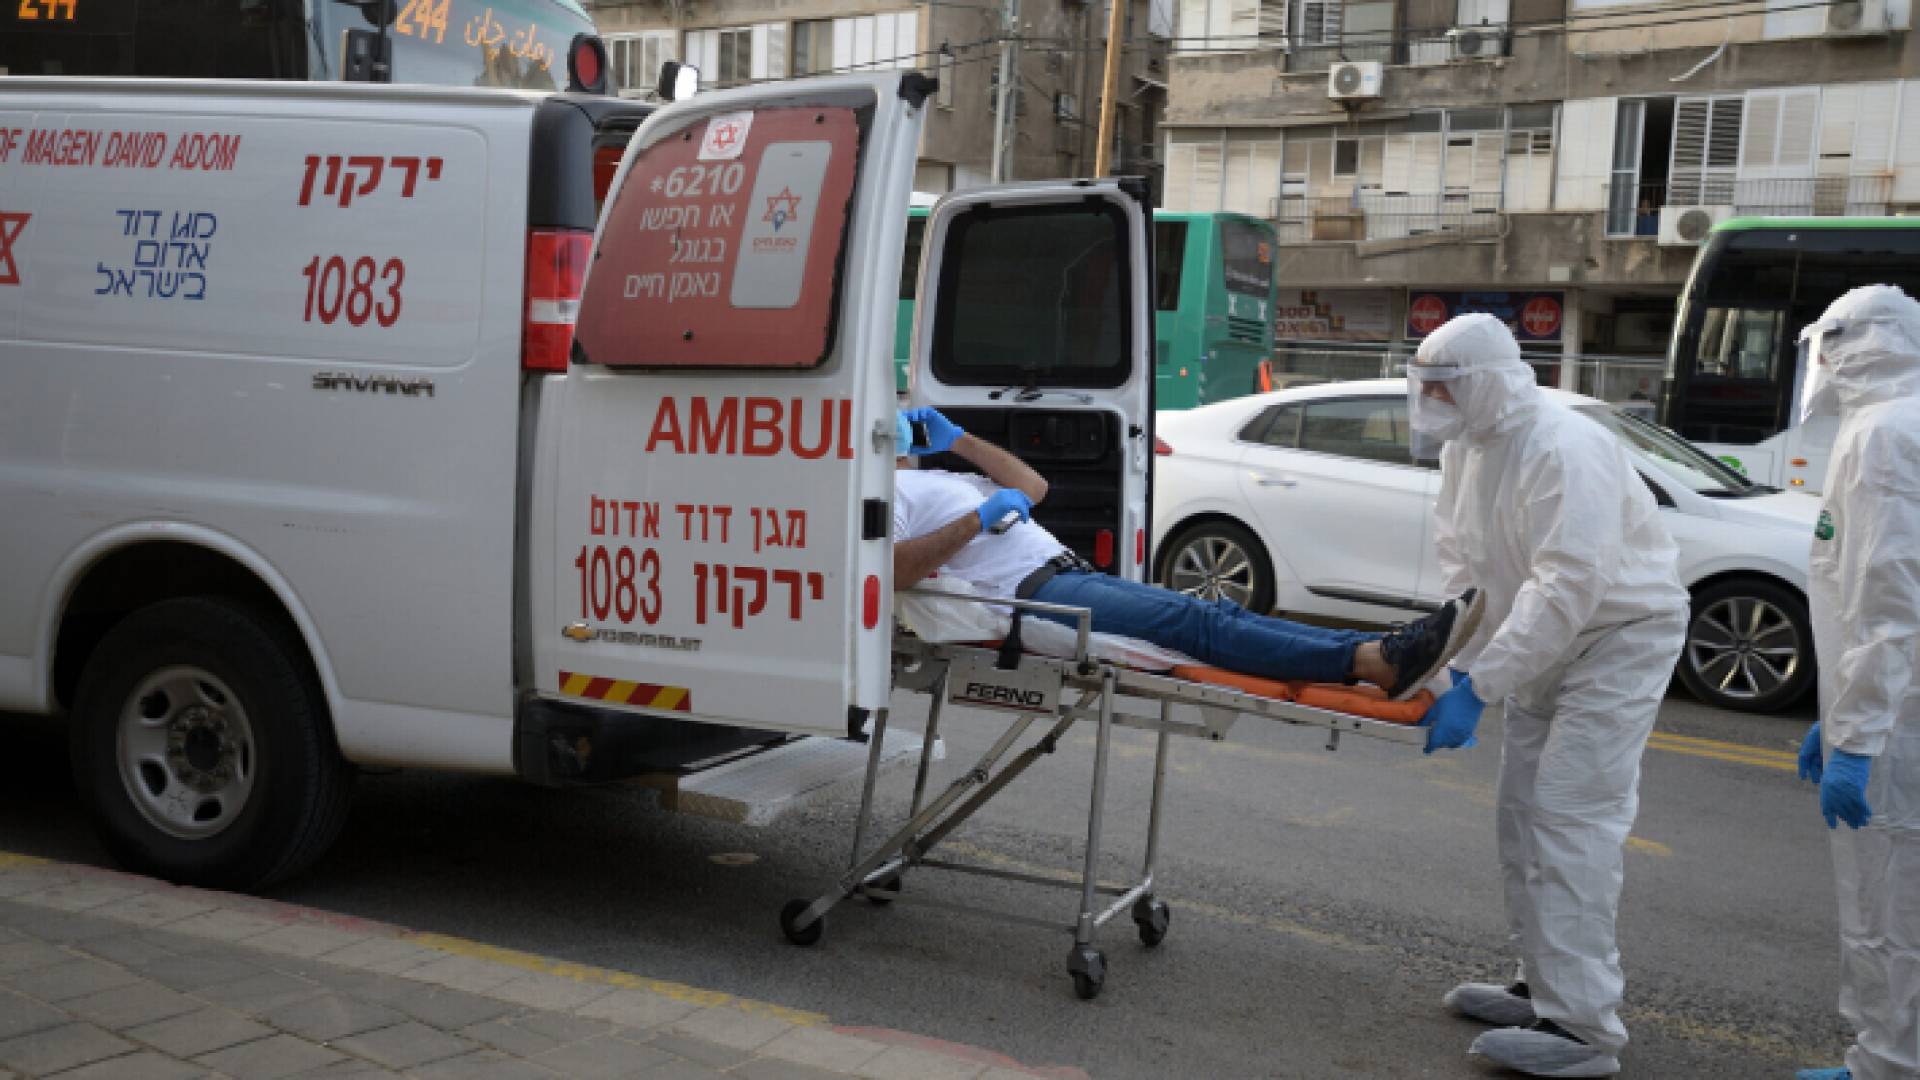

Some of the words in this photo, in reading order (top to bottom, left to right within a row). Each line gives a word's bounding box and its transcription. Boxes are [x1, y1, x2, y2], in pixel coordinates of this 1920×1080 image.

[396, 0, 449, 43] 244
[23, 128, 102, 165] MAGEN
[102, 131, 167, 168] DAVID
[169, 133, 241, 171] ADOM
[298, 154, 443, 208] ירקון
[116, 209, 162, 236] דוד
[169, 211, 218, 241] מגן
[640, 204, 702, 230] חפשו
[708, 205, 735, 228] או
[134, 241, 210, 269] אדום
[669, 236, 726, 263] בגוגל
[94, 262, 207, 301] בישראל
[302, 255, 405, 327] 1083
[623, 275, 666, 298] חיים
[669, 272, 721, 303] נאמן
[312, 371, 436, 398] SAVANA
[590, 495, 660, 539] אדום
[675, 504, 732, 544] דוד
[751, 507, 806, 553] מגן
[575, 545, 662, 625] 1083
[694, 562, 824, 629] ירקון
[966, 682, 1044, 705] FERNO
